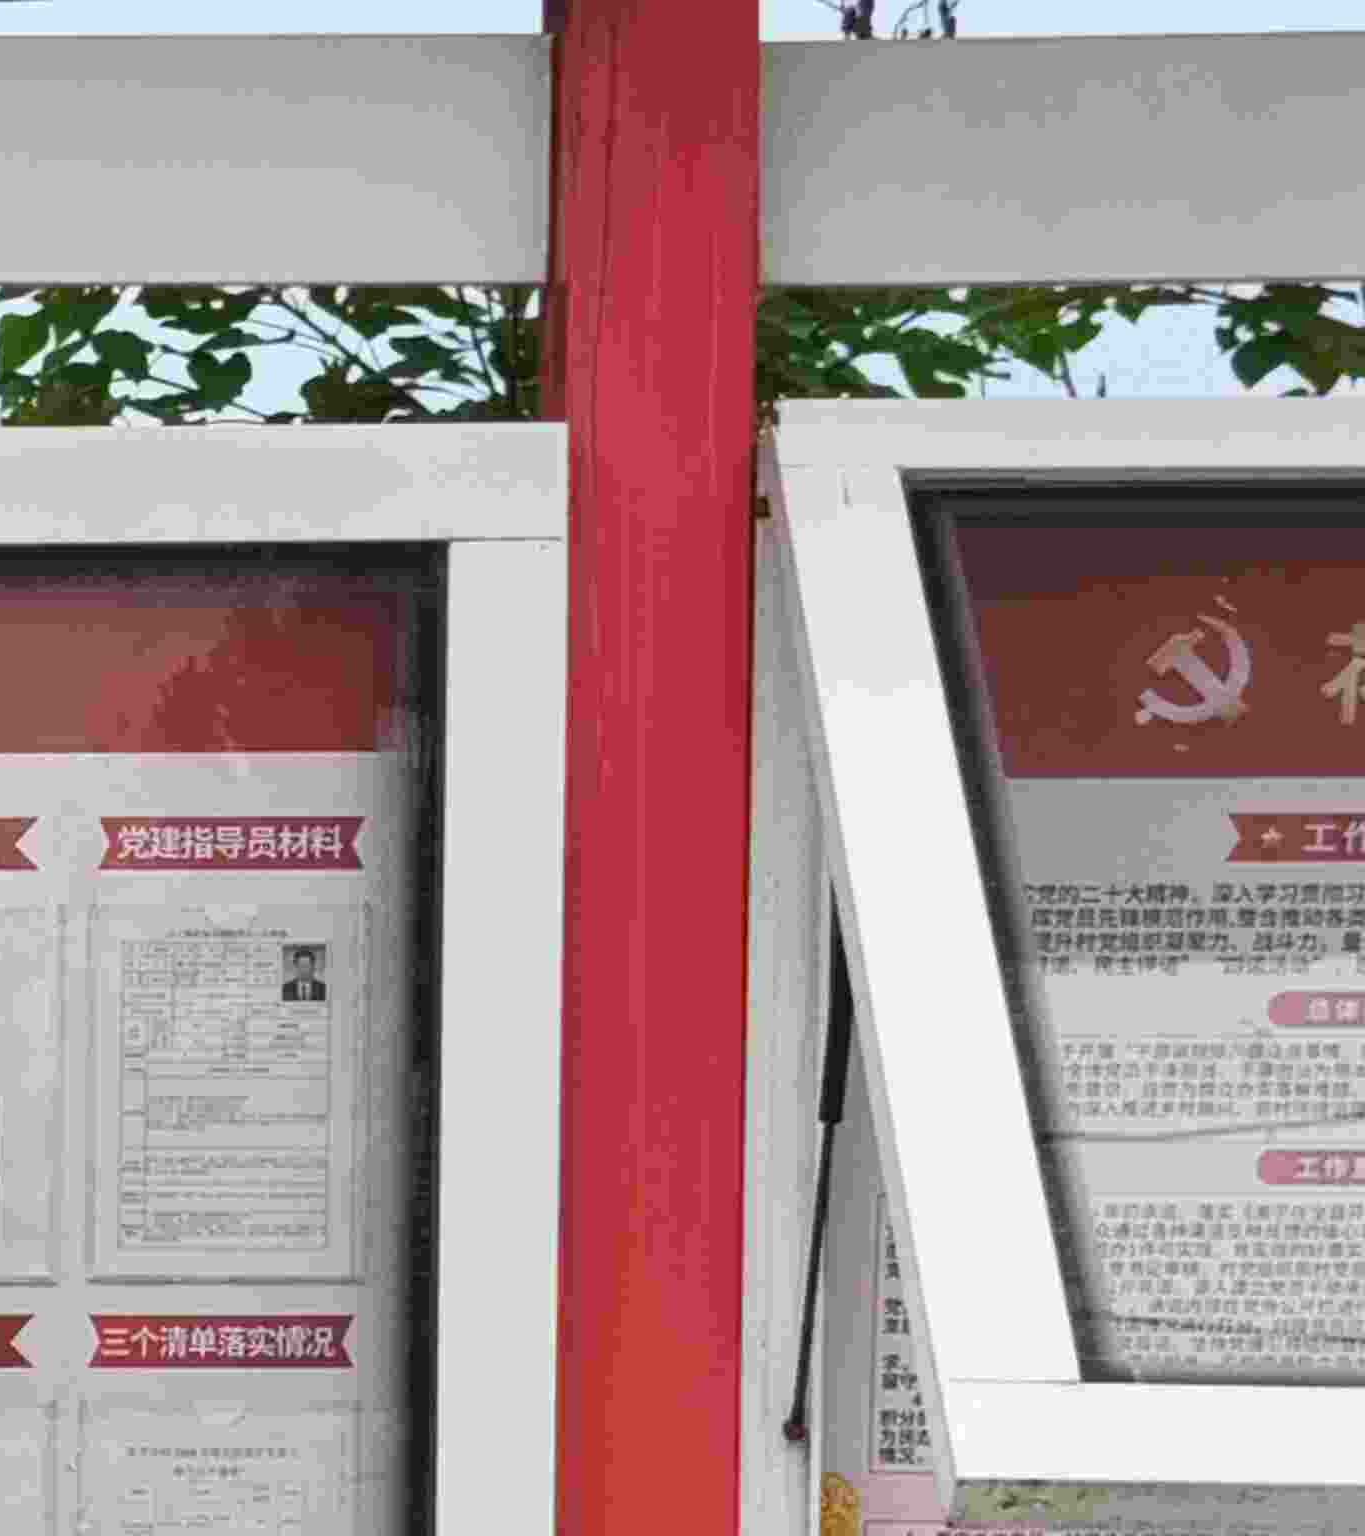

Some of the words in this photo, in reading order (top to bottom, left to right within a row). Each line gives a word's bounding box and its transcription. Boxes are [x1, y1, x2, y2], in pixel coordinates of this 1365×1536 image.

[116, 825, 343, 861] 党建指导员材料
[101, 1323, 336, 1361] 三个清单落实情况
